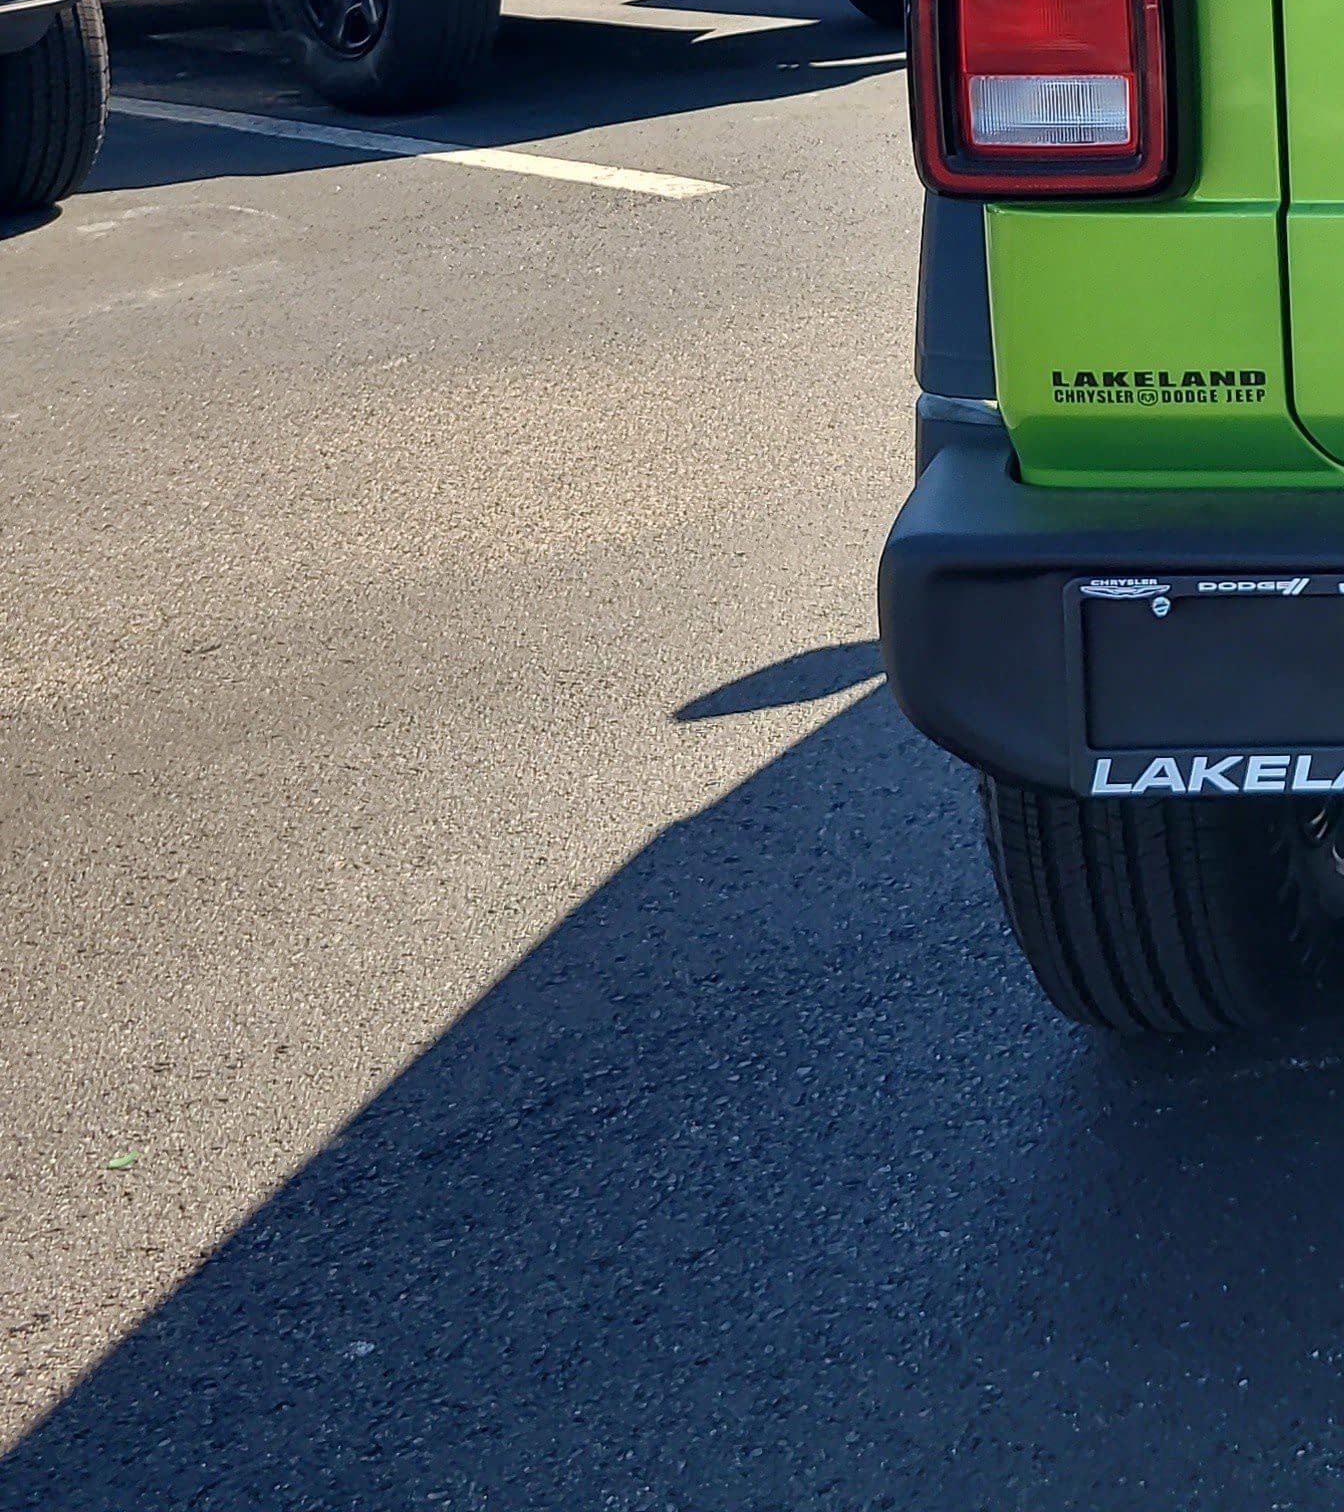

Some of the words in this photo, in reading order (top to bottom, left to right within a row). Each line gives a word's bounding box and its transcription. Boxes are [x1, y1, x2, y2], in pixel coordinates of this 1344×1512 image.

[1052, 371, 1266, 387] LAKELAND
[1054, 389, 1134, 403] CHRYSLER
[1162, 389, 1218, 403] DODGE
[1226, 389, 1266, 403] JEEP
[1090, 578, 1158, 586] CHRYSLER
[1198, 581, 1299, 593] DODGE
